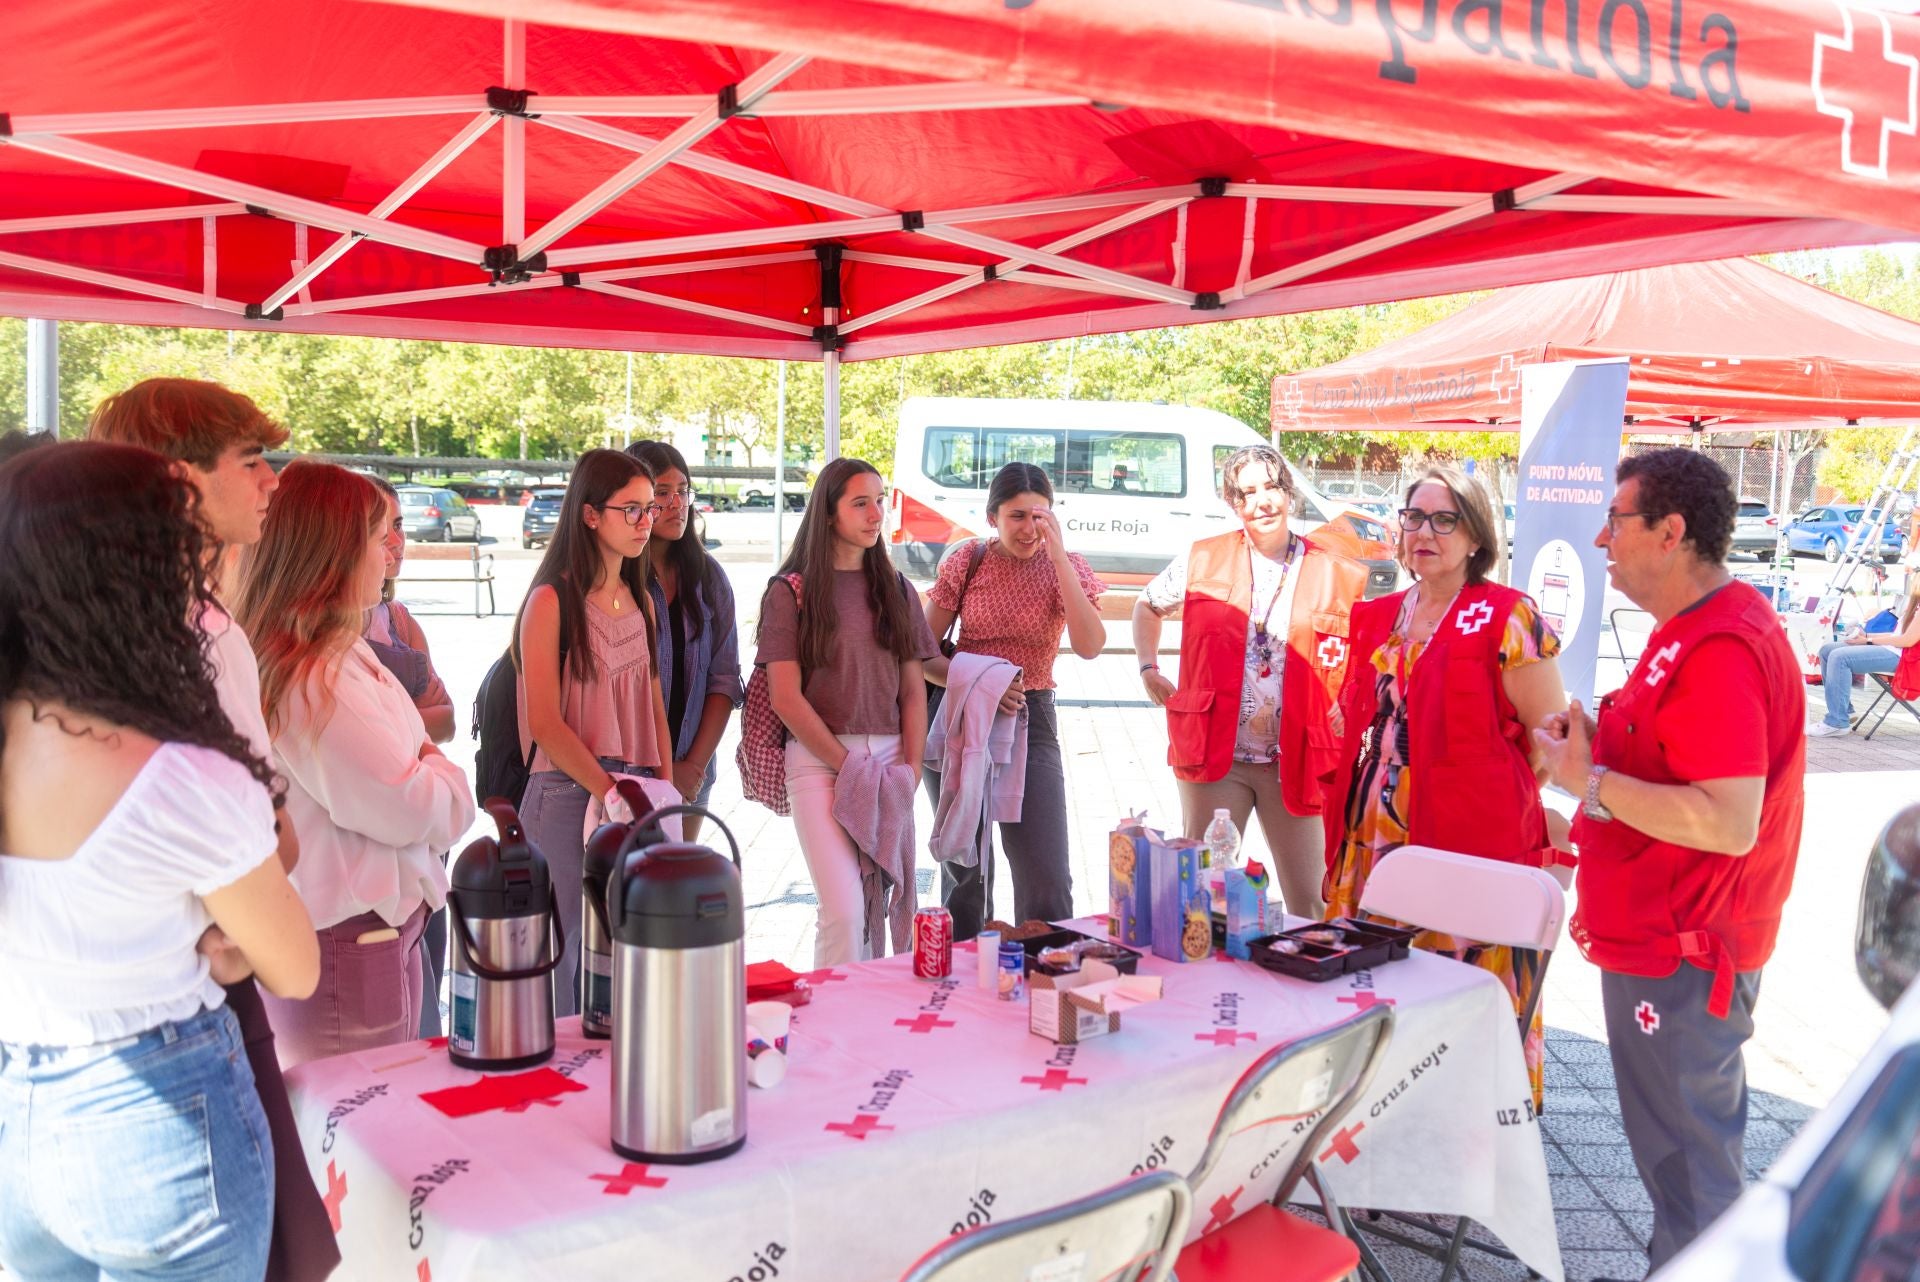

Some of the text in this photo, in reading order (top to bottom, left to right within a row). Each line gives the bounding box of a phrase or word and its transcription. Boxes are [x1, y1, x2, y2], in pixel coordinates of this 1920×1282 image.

[1312, 367, 1477, 416] Cruz Roja Española
[1529, 462, 1604, 482] PUNTO MÓVIL
[1526, 486, 1604, 504] DE ACTIVIDAD
[1067, 519, 1149, 536] Cruz Roja
[1212, 992, 1244, 1026] Cruz Roja
[857, 1069, 913, 1111] Cruz Roja
[1370, 1078, 1409, 1118] Cruz
[322, 1083, 390, 1154] Cruz Roja
[409, 1158, 471, 1251] Cruz Roja
[728, 1241, 787, 1282] oja
